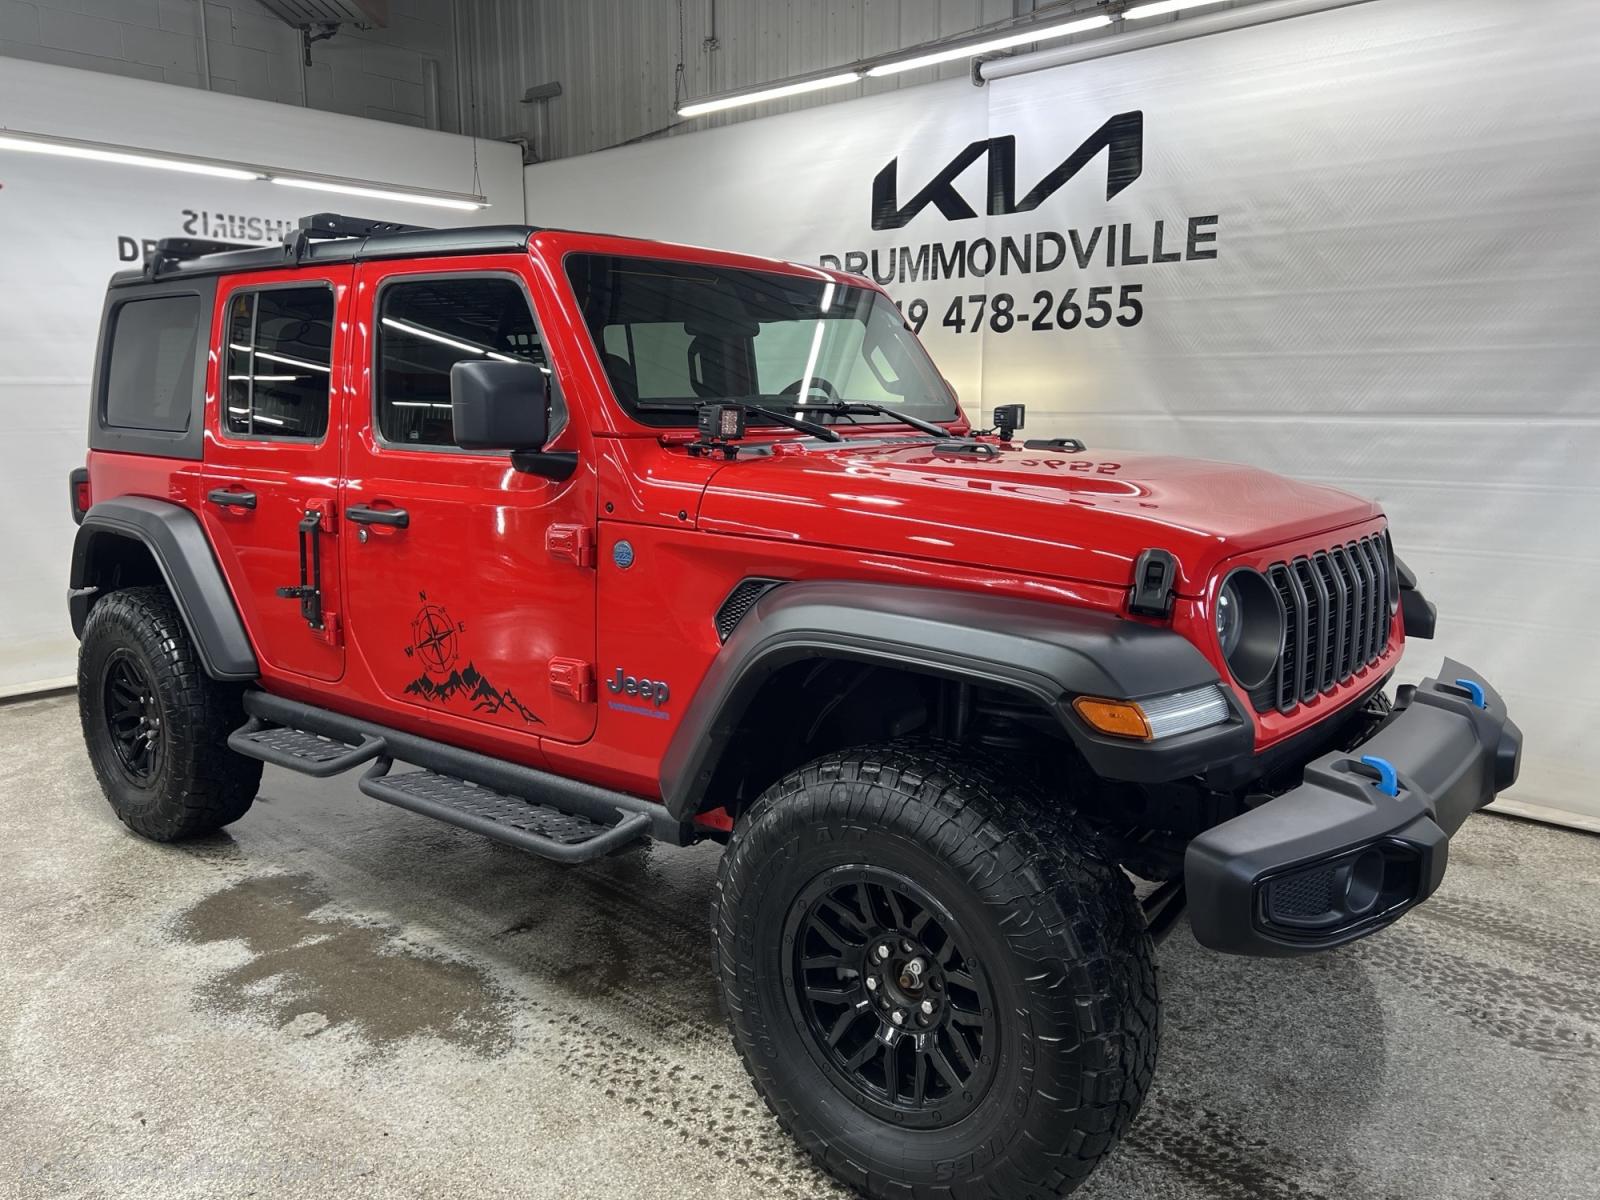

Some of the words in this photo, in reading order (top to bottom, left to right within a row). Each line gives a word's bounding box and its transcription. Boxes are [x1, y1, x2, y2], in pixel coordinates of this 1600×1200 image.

[871, 109, 1143, 230] KIA
[942, 284, 1144, 334] 478-2655
[606, 667, 670, 707] Jeep
